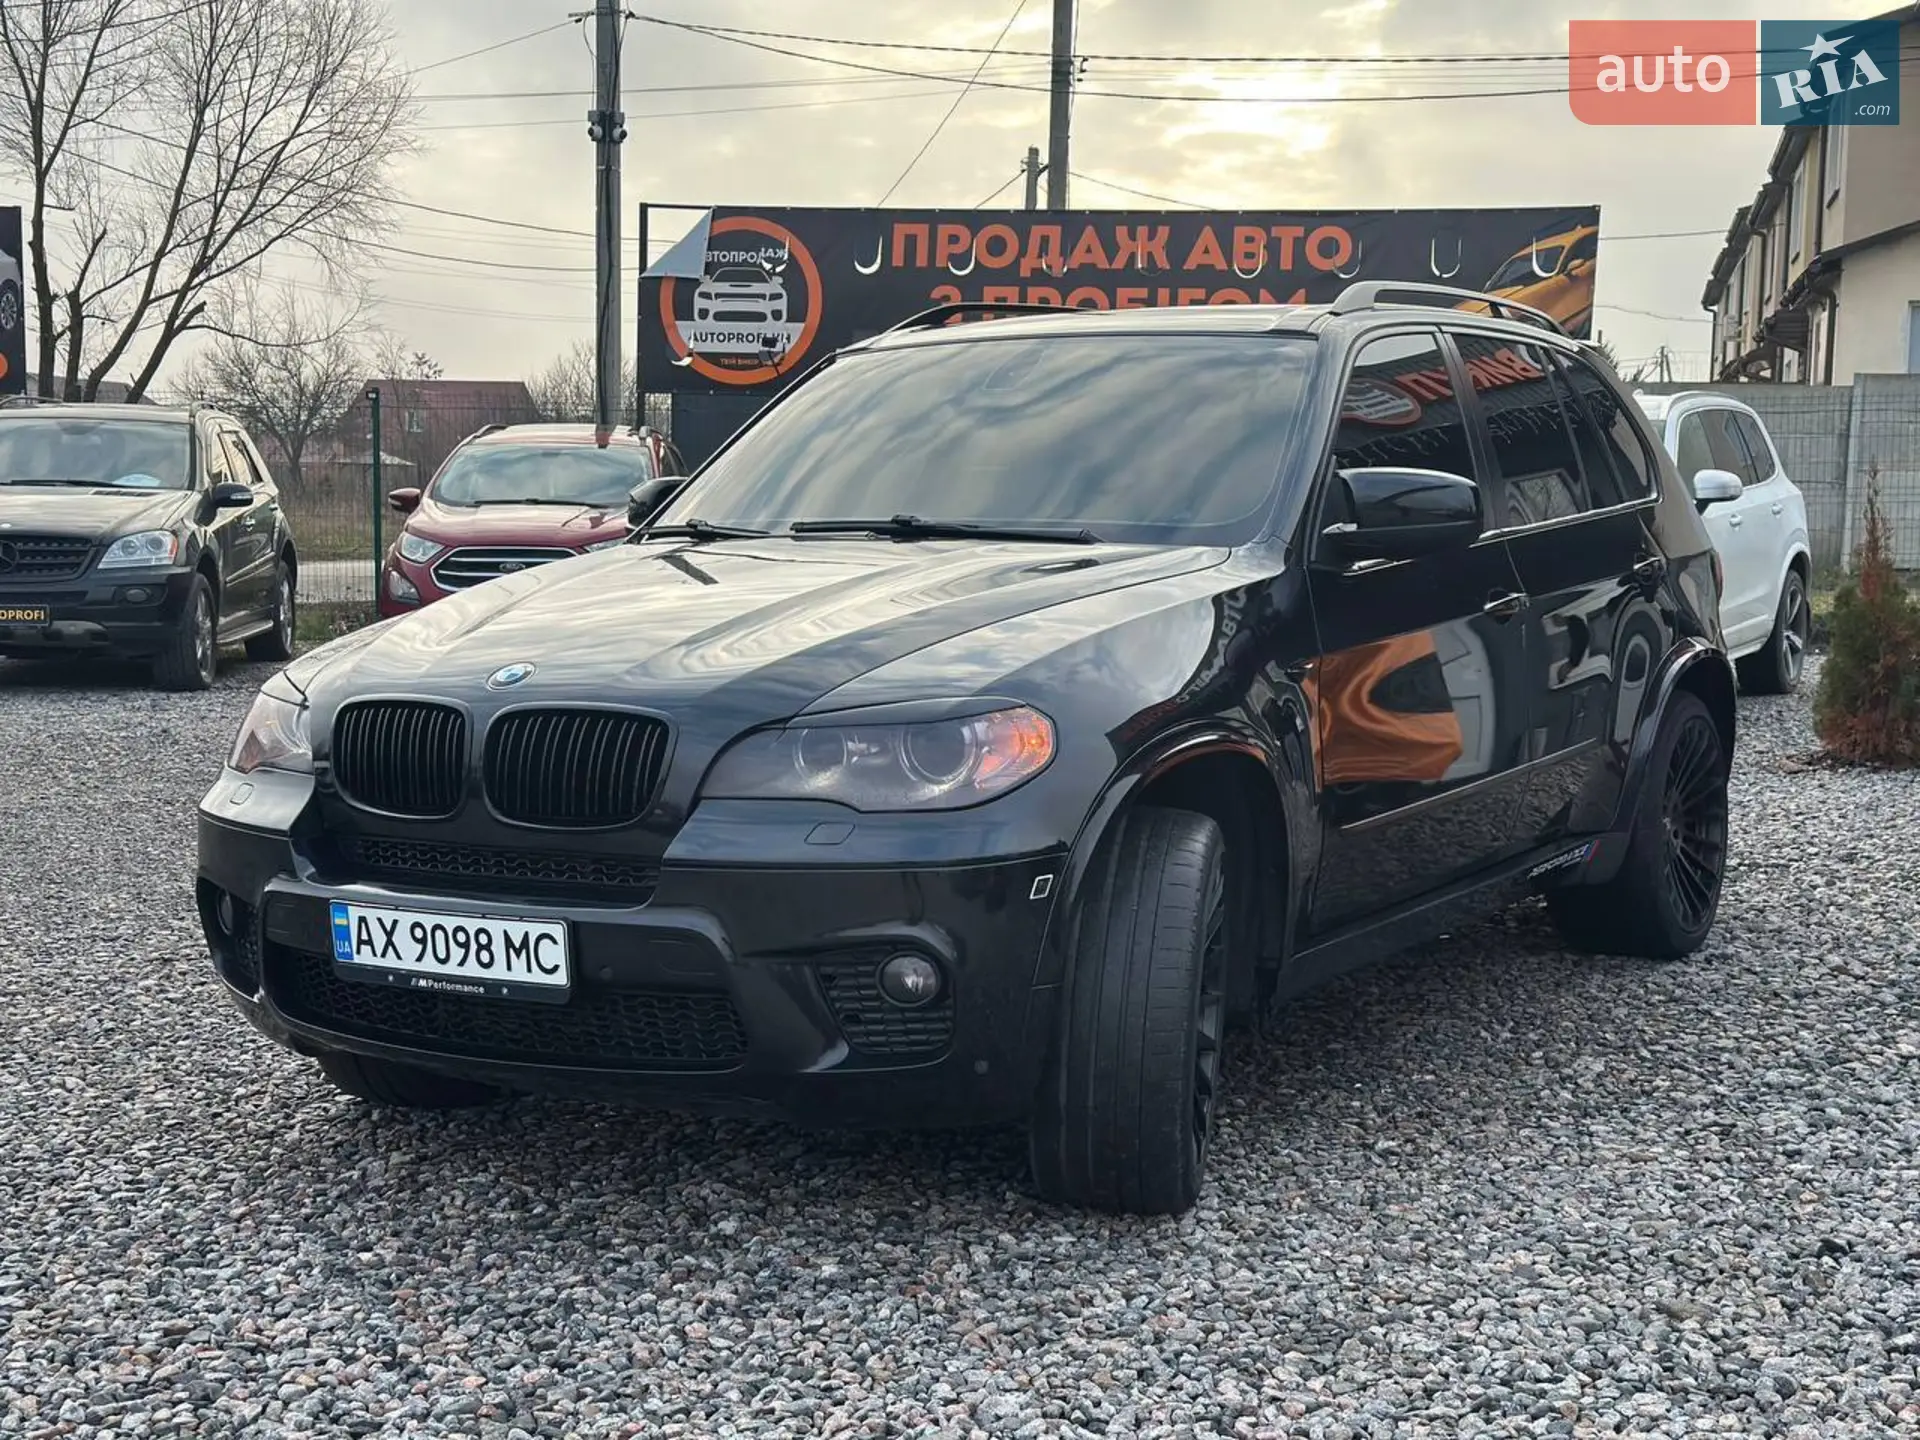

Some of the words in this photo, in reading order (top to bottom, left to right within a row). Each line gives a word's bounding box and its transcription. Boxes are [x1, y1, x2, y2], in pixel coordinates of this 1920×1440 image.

[892, 223, 1173, 277] ПРОДАЖ
[1182, 225, 1353, 271] АВТО
[337, 941, 350, 954] UA
[355, 915, 402, 960] AX
[410, 921, 495, 969] 9098
[503, 929, 560, 975] MC
